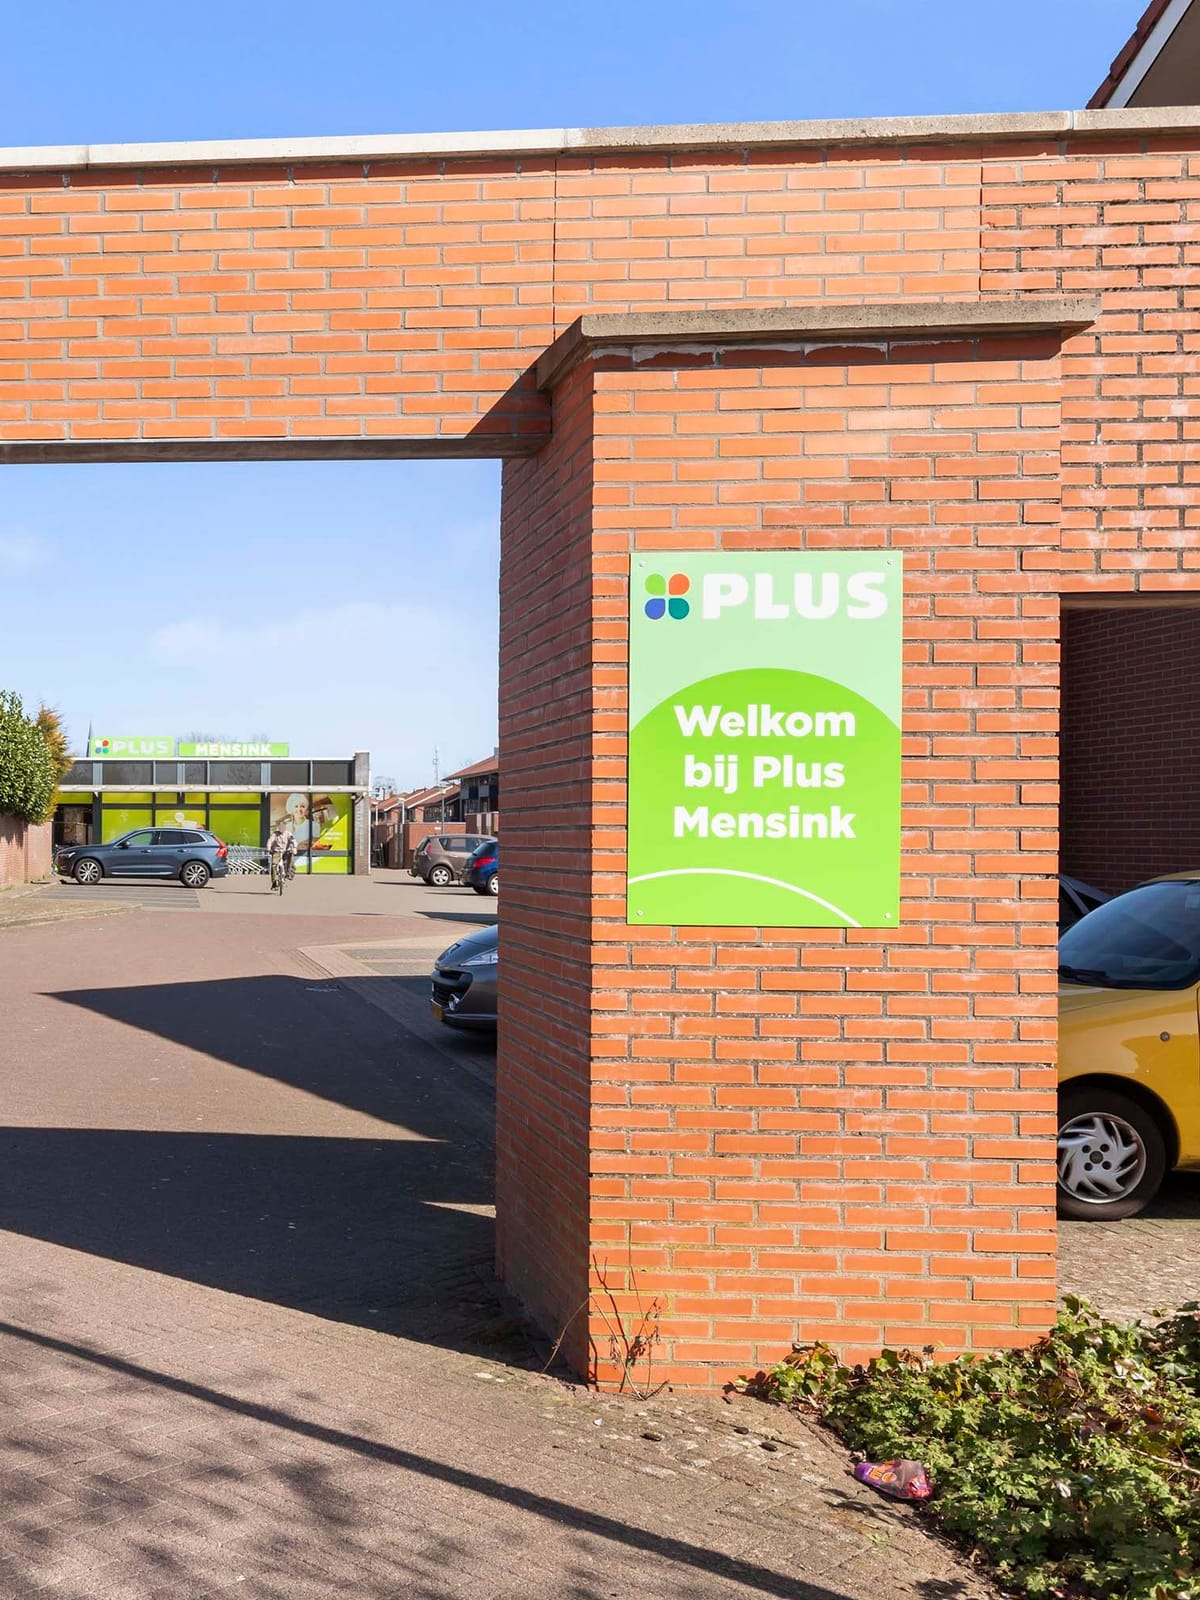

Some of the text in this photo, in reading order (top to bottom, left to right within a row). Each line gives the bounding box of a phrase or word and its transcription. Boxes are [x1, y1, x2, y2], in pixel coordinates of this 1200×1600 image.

[702, 571, 888, 620] PLUS
[674, 704, 856, 737] Welkom
[113, 739, 169, 755] PLUS
[195, 743, 272, 757] MENSINK
[684, 754, 845, 794] bij Plus
[673, 805, 857, 839] Mensink
